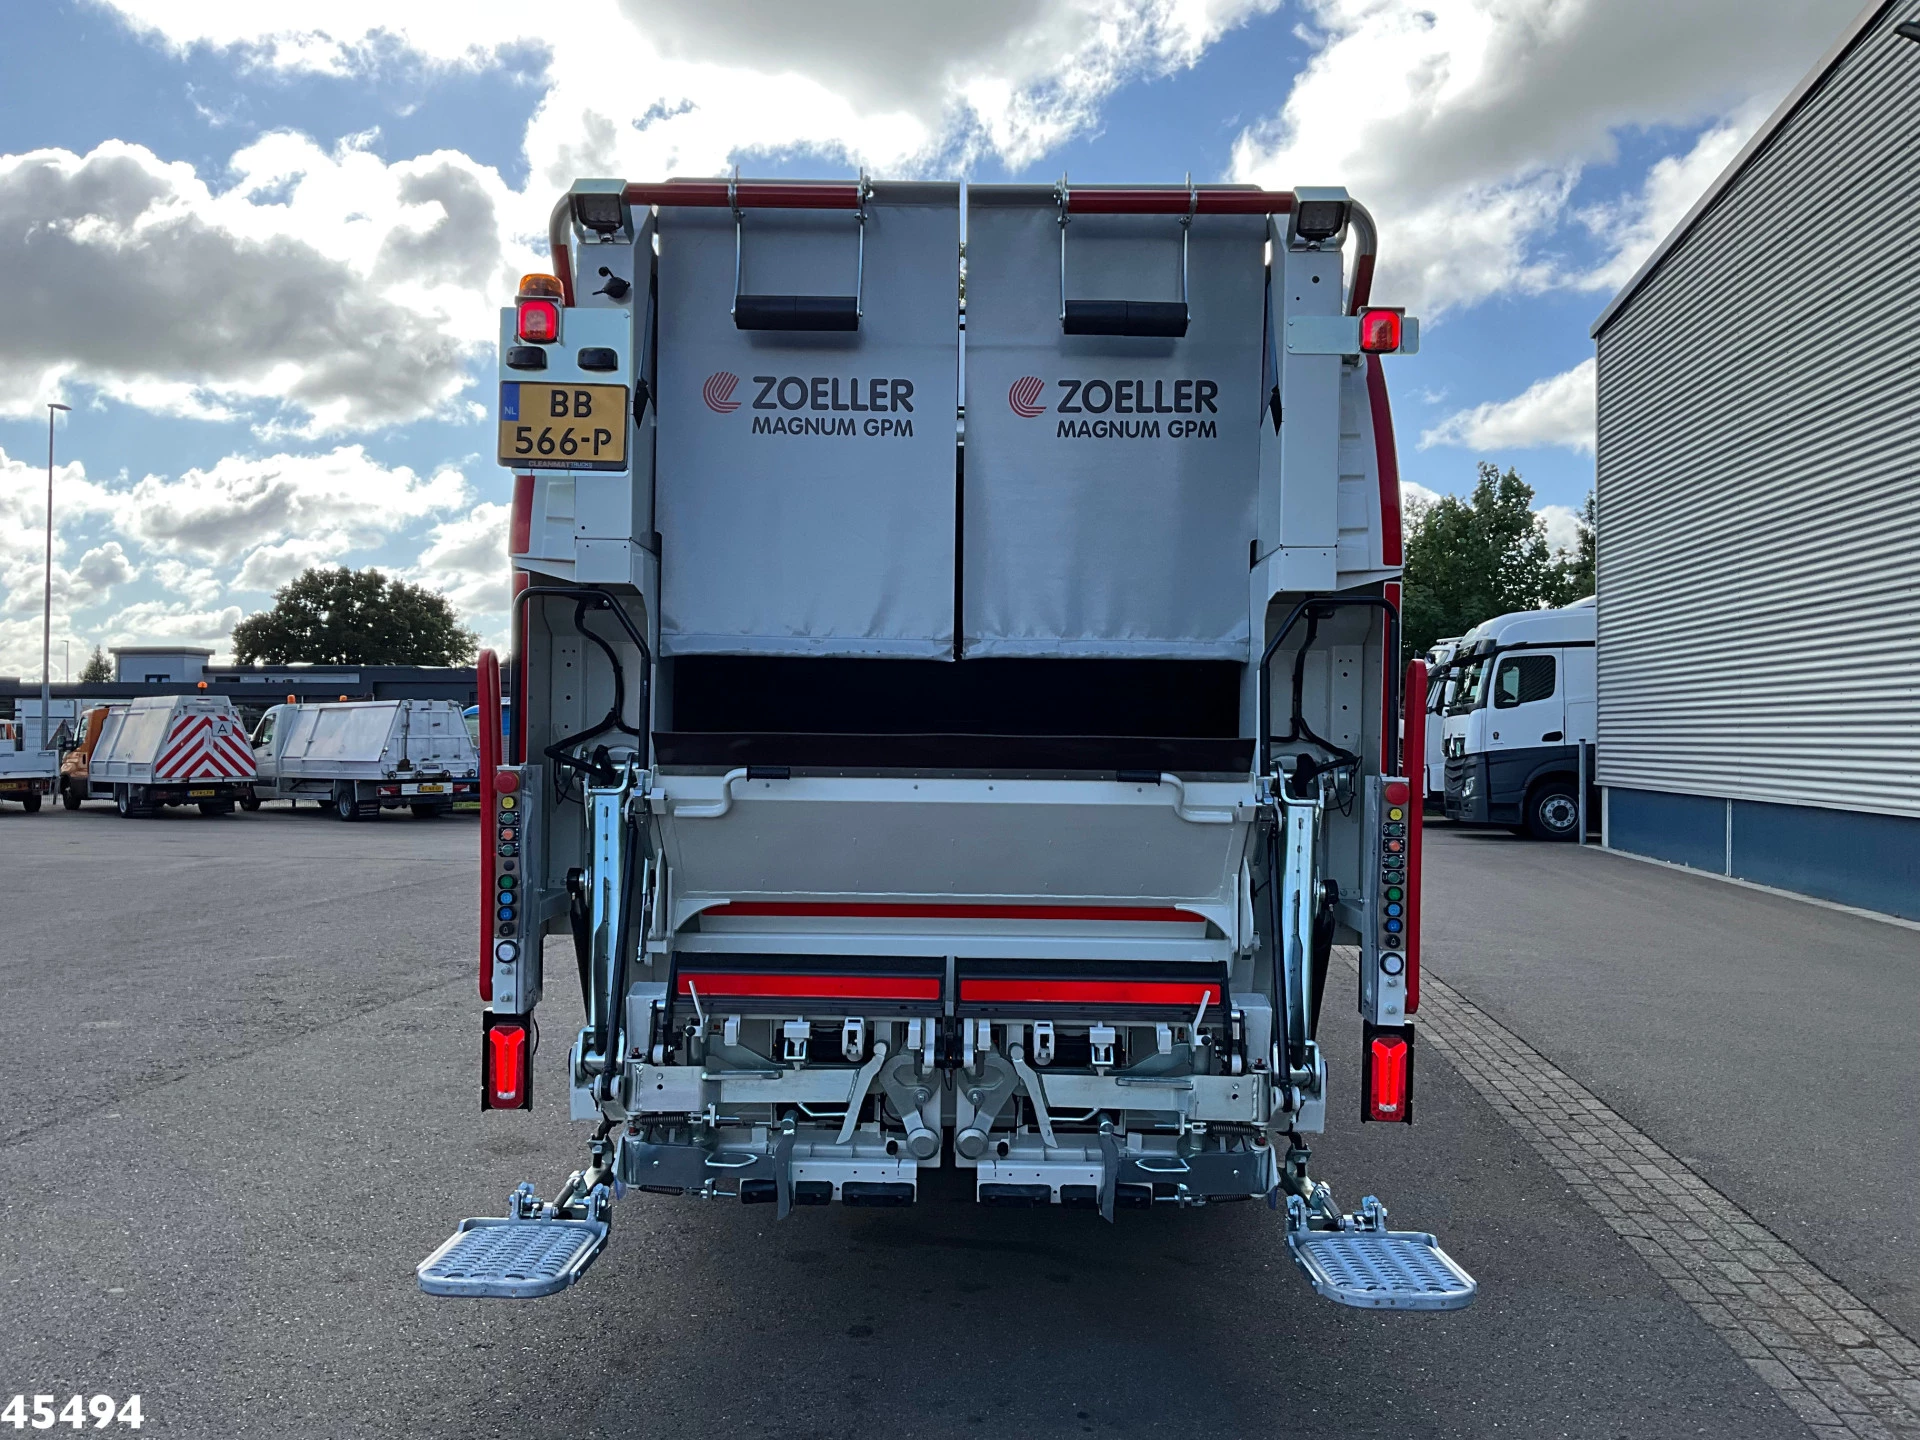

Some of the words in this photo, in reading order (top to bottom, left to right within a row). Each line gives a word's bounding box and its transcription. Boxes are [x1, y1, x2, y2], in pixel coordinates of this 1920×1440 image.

[550, 389, 592, 418] BB
[752, 376, 914, 412] ZOELLER
[1057, 380, 1218, 413] ZOELLER
[504, 406, 517, 415] NL
[752, 416, 856, 436] MAGNUM
[863, 418, 913, 437] GPM
[1056, 420, 1160, 438] MAGNUM
[1167, 420, 1217, 438] GPM
[515, 426, 612, 456] 566-P
[217, 723, 228, 734] A
